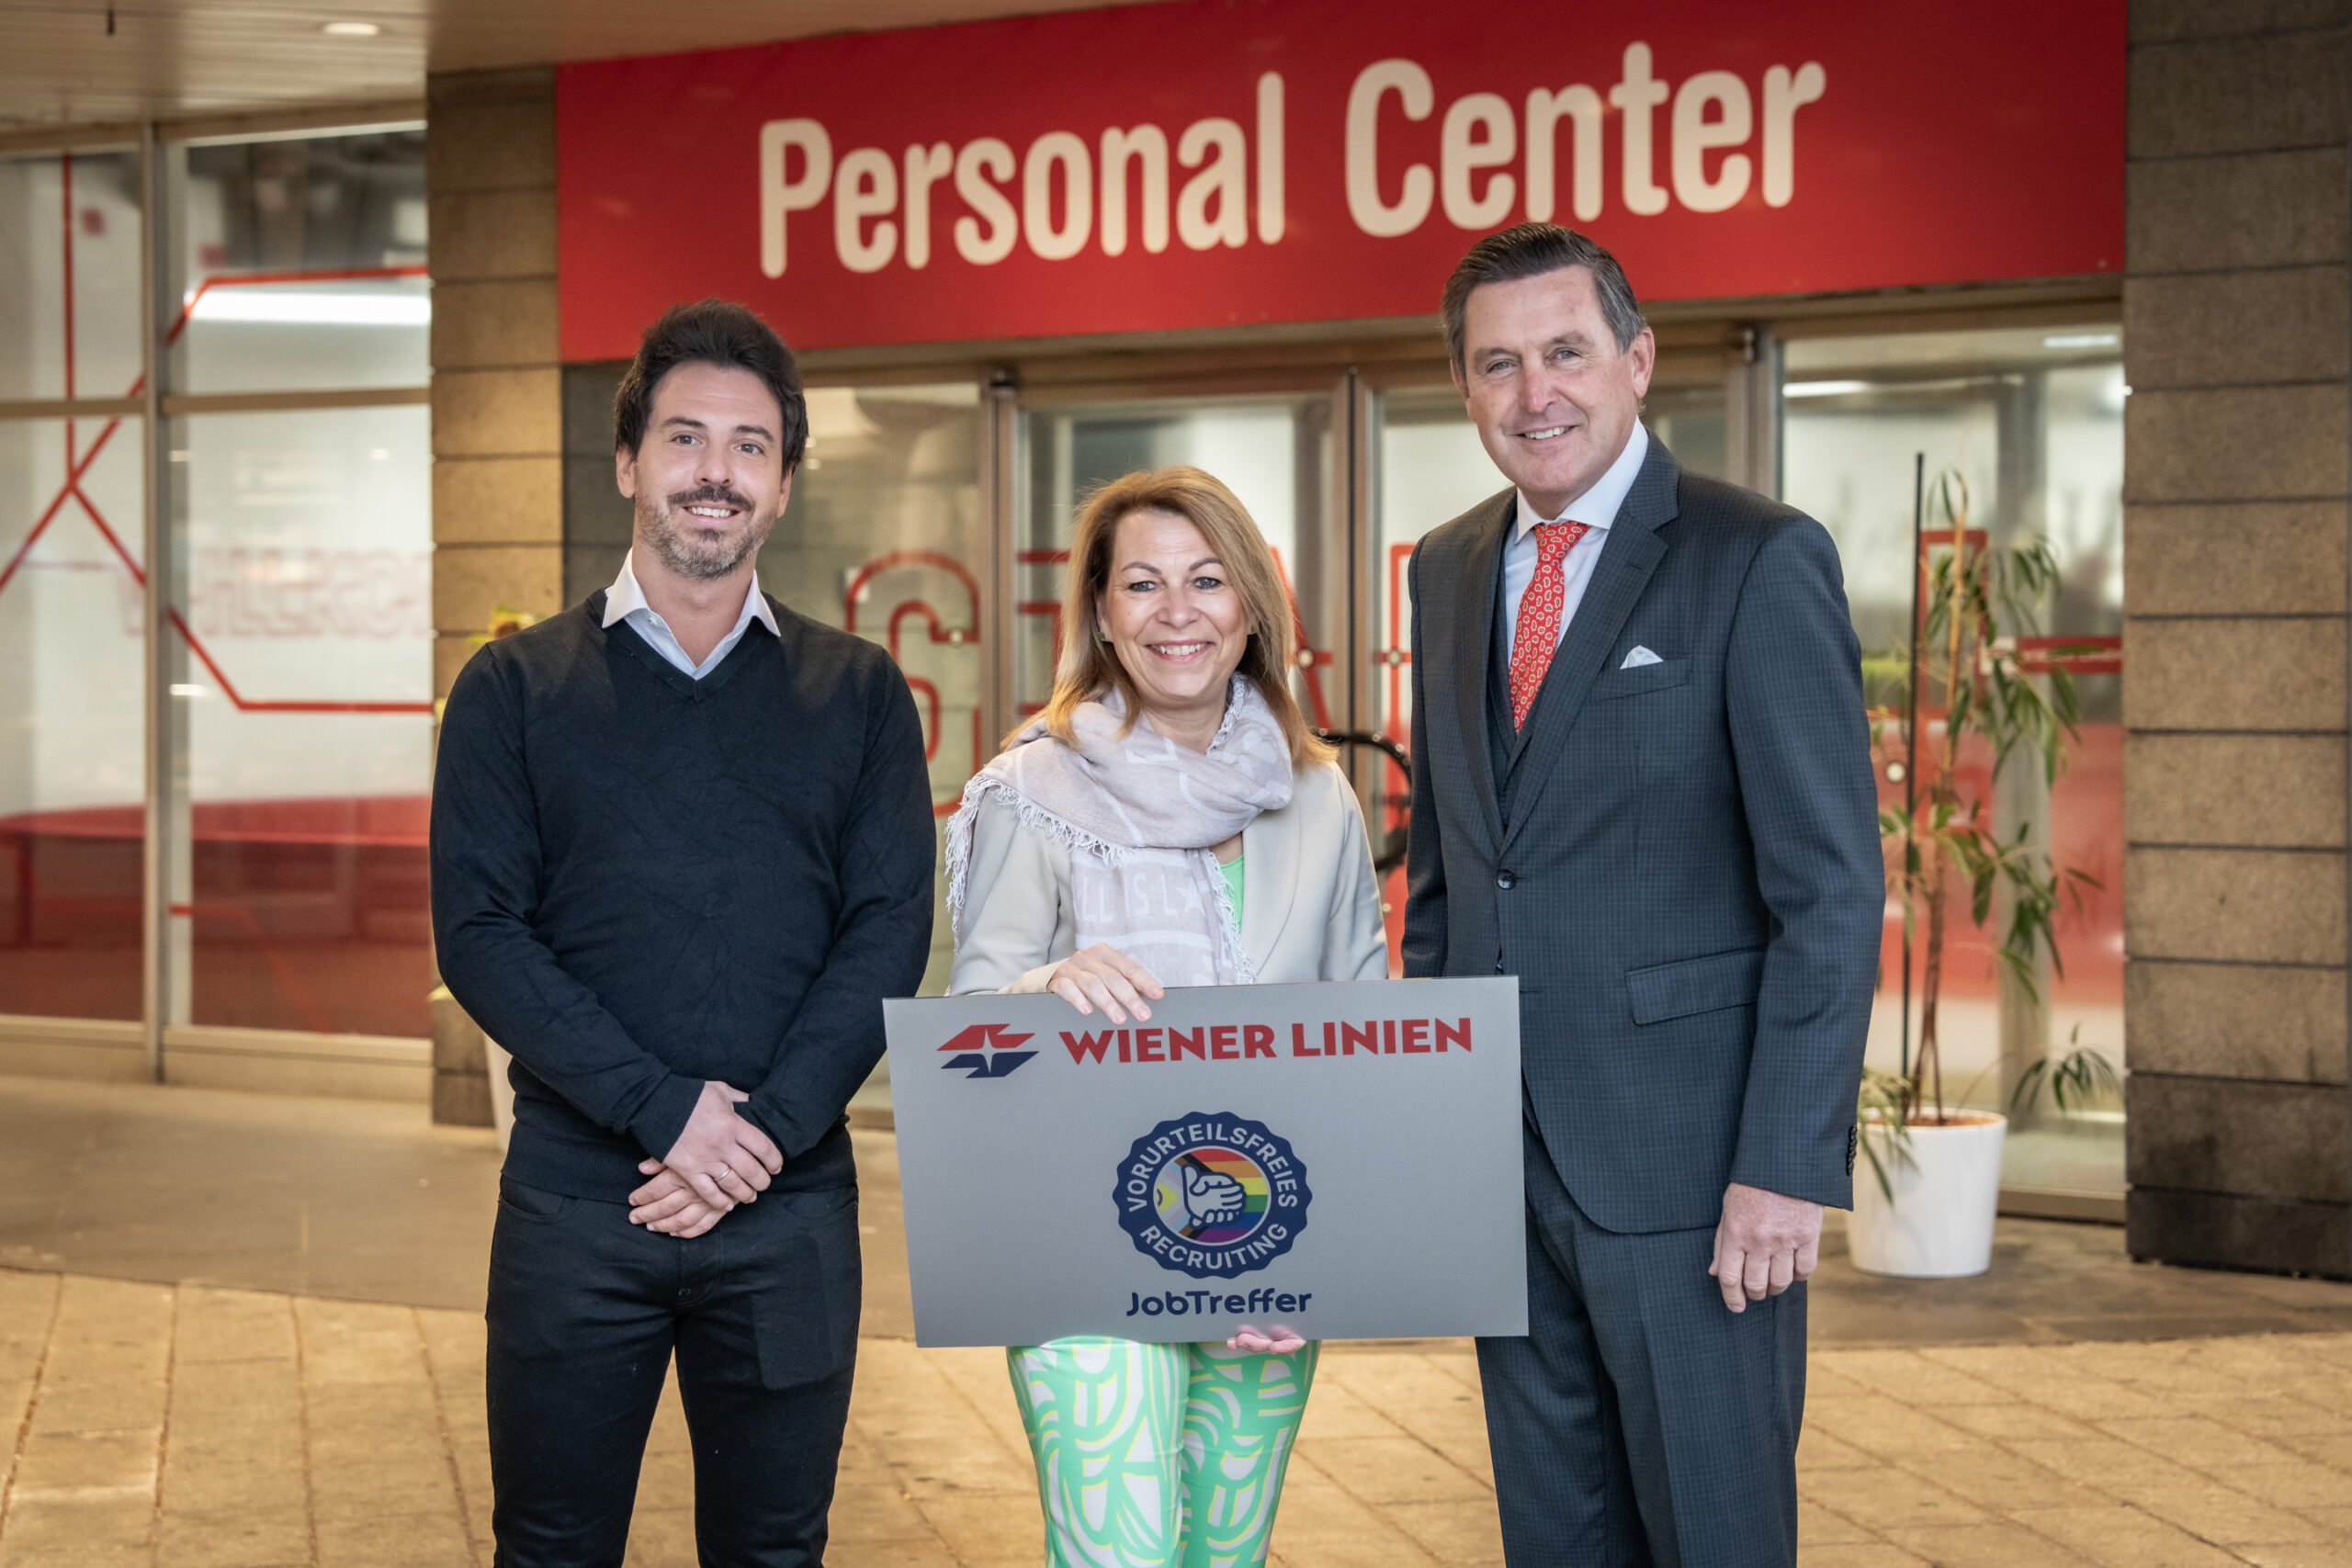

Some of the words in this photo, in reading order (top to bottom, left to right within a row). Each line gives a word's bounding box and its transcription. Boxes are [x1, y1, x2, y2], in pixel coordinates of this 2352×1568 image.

[760, 72, 1286, 279] Personal
[1344, 41, 1826, 238] Center
[1058, 1024, 1277, 1065] WIENER
[1291, 1017, 1472, 1057] LINIEN
[1126, 1122, 1298, 1213] VORURTEILSFREIES
[1139, 1224, 1288, 1269] RECRUITING
[1125, 1287, 1313, 1317] JobTreffer
